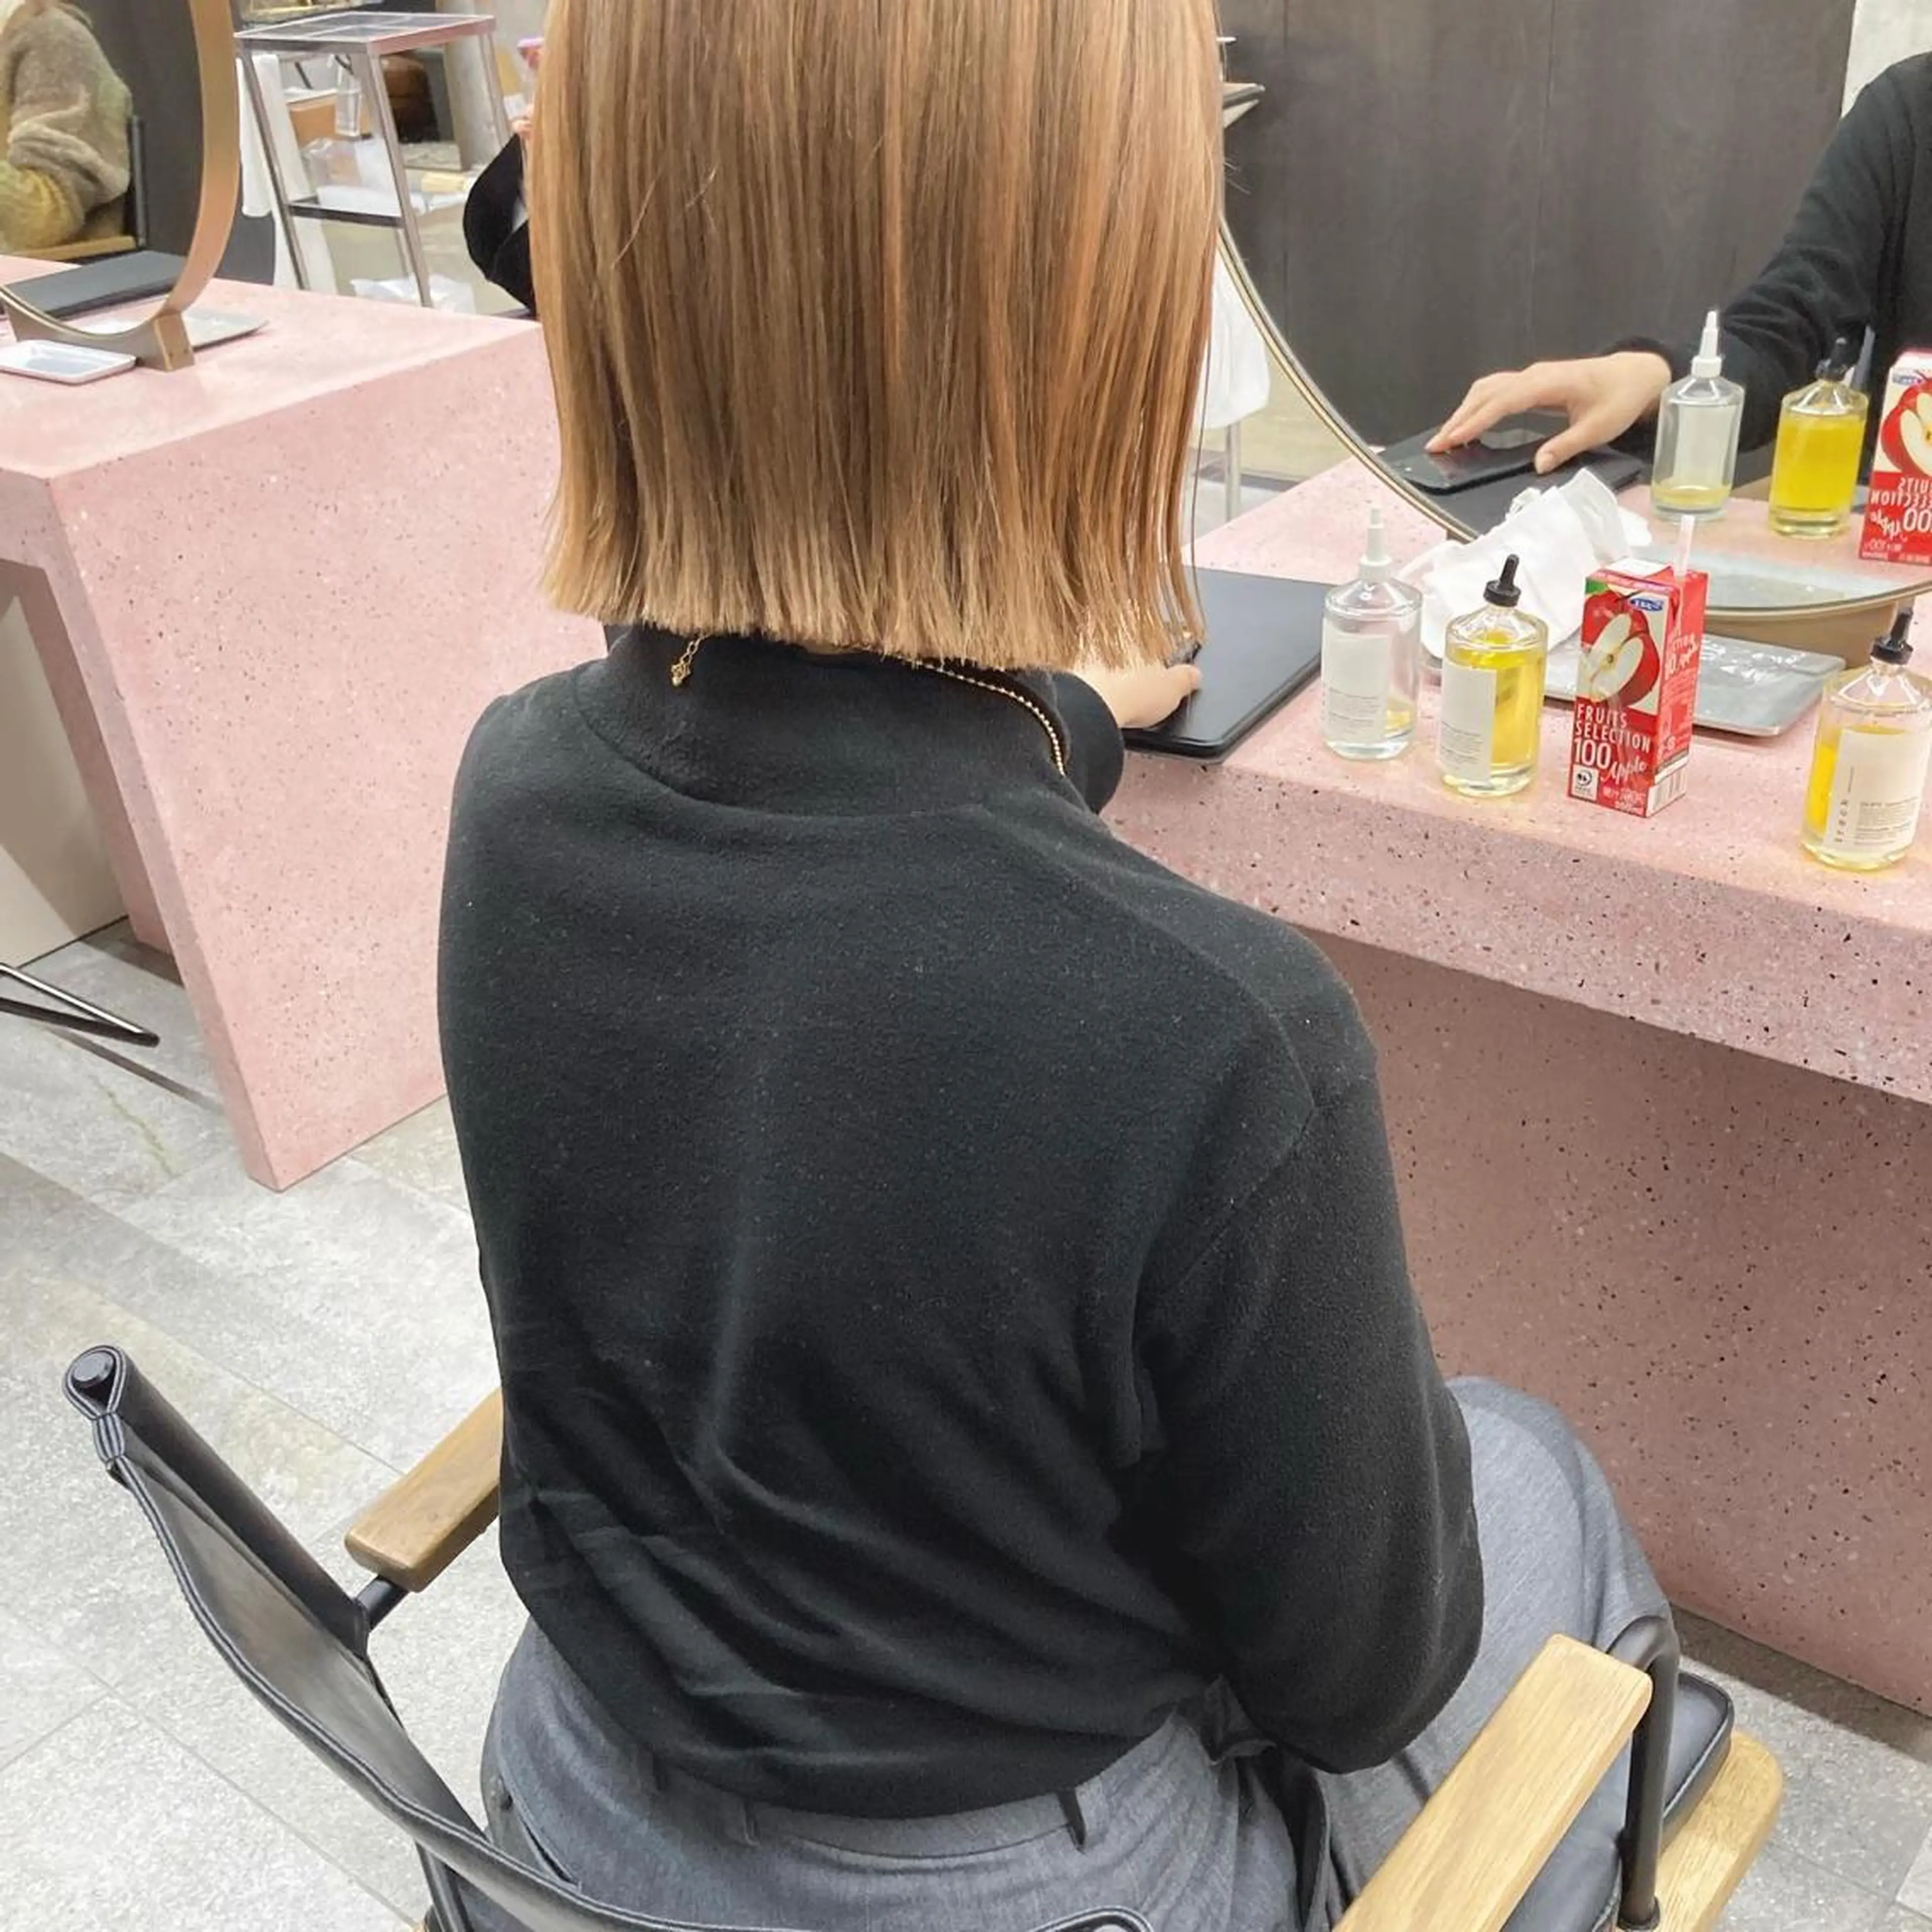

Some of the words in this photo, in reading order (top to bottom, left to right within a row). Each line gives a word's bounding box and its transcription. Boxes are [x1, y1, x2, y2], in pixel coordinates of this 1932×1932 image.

[1577, 703, 1627, 728] FRUITS
[1575, 720, 1651, 753] SELECTION
[1574, 738, 1612, 769] 100
[1600, 755, 1647, 785] Apple
